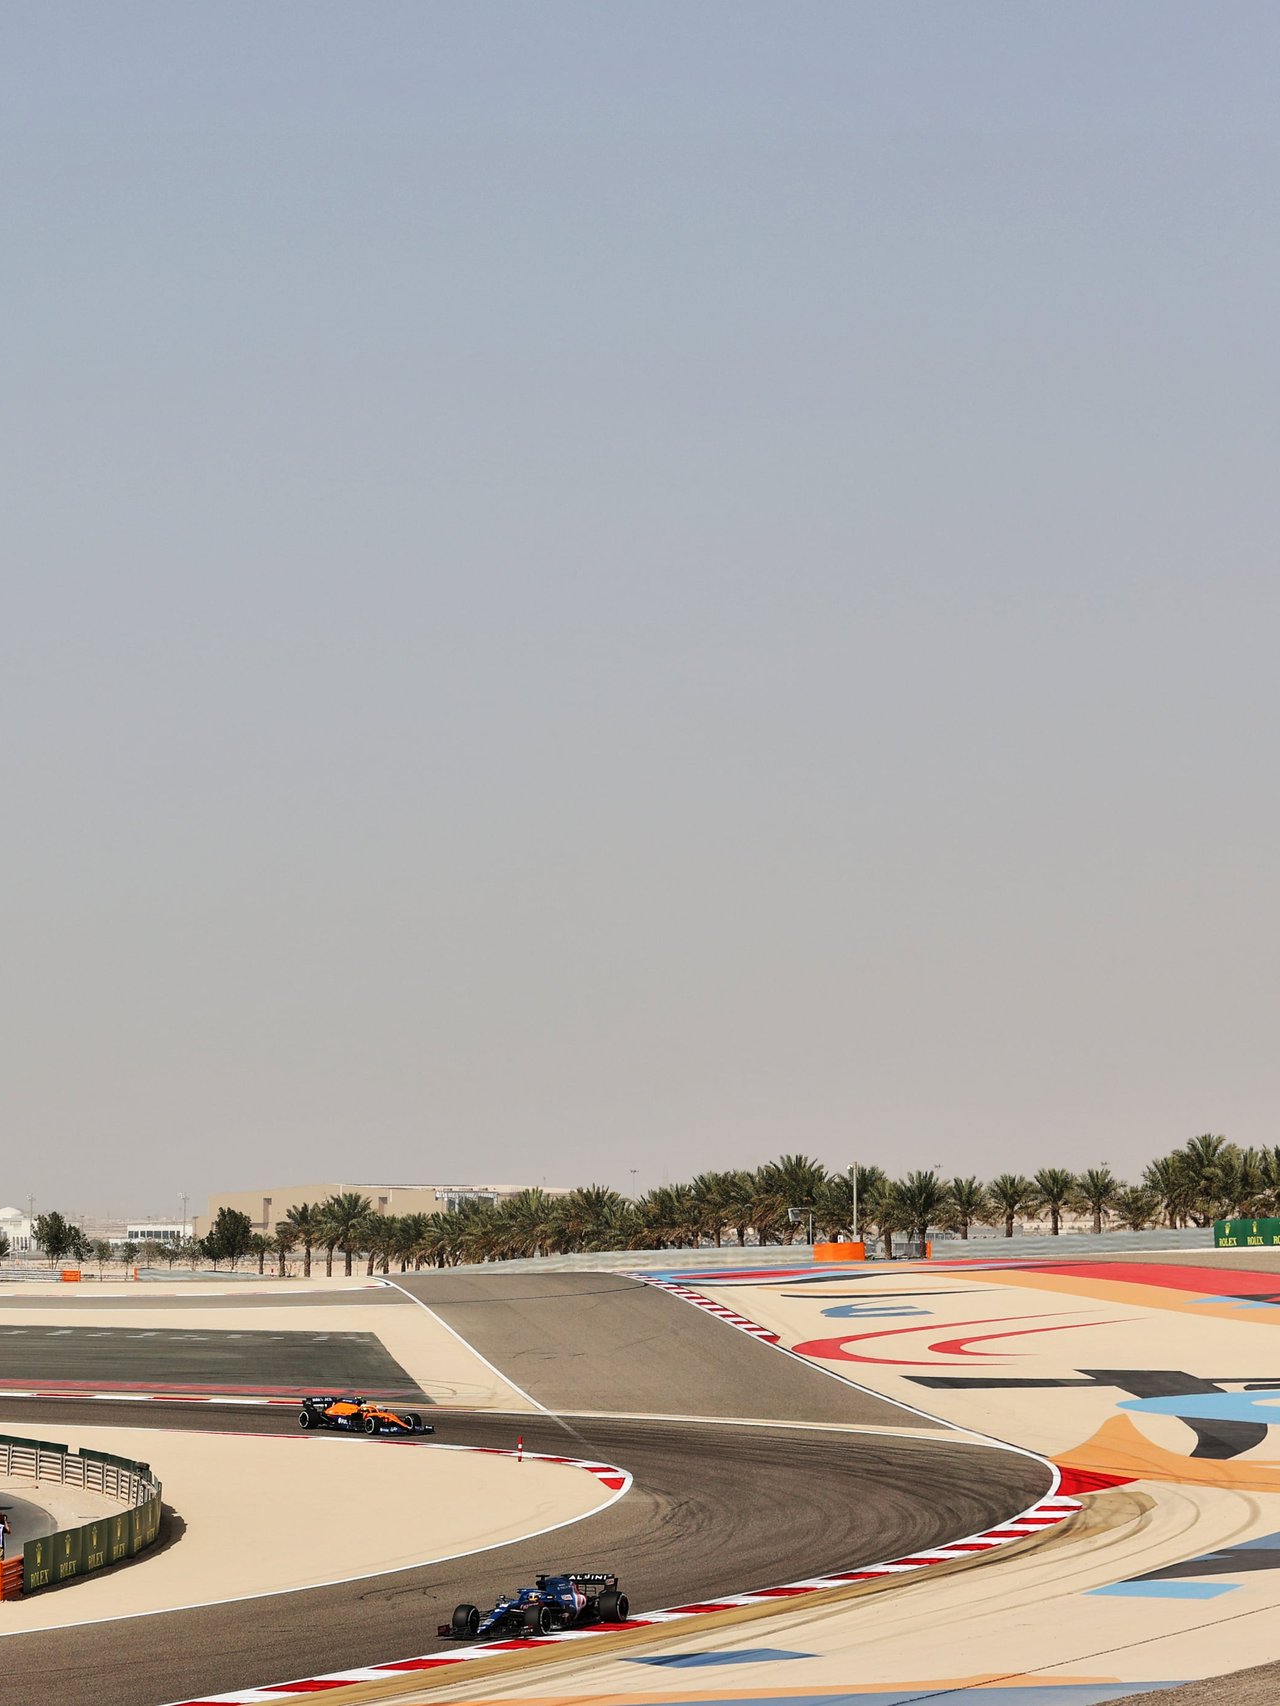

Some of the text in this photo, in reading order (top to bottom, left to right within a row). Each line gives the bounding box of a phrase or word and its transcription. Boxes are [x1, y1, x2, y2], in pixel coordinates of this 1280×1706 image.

[1219, 1237, 1237, 1247] ROLEX
[1247, 1236, 1264, 1246] ROLEX
[60, 1560, 77, 1579] ROLEX
[88, 1552, 104, 1570] ROLEX
[30, 1569, 49, 1589] ROLEX
